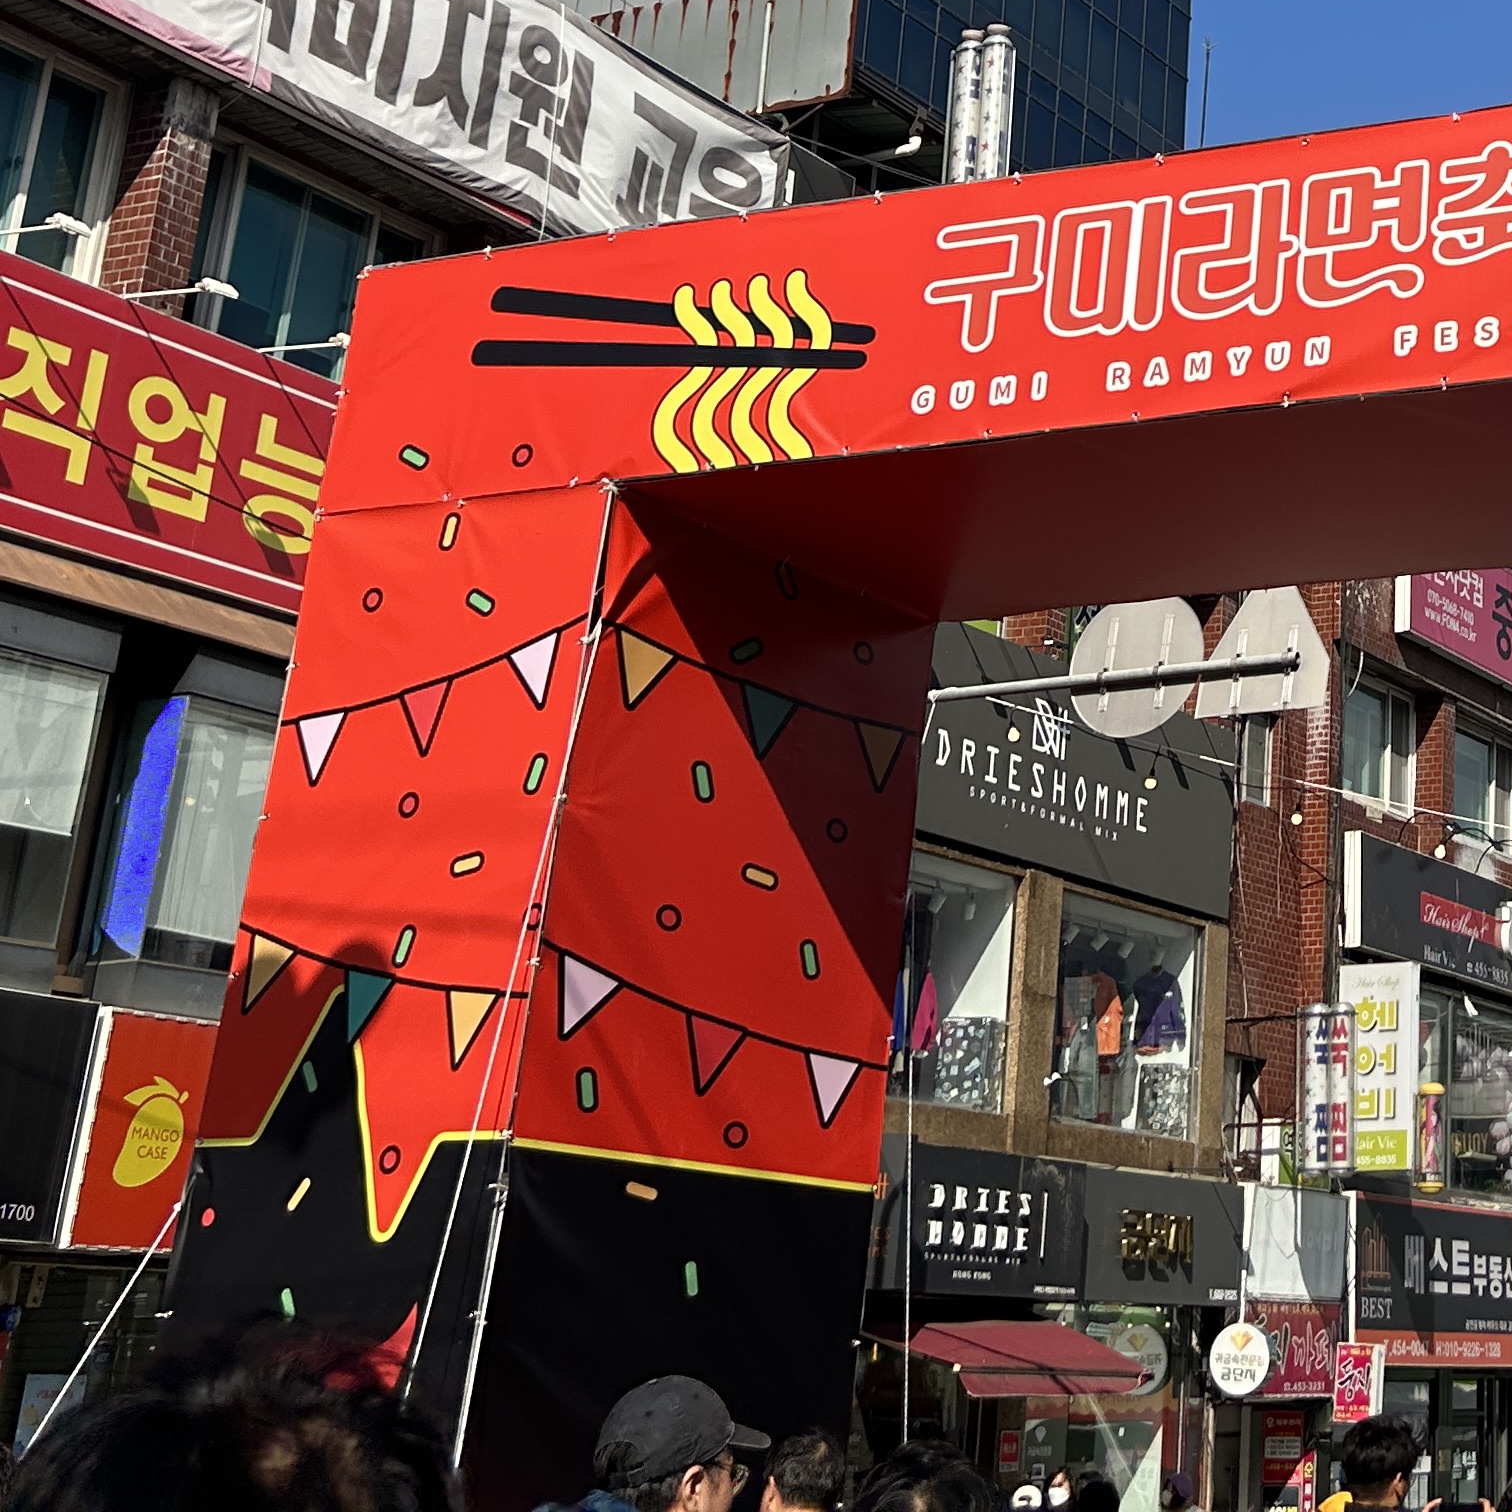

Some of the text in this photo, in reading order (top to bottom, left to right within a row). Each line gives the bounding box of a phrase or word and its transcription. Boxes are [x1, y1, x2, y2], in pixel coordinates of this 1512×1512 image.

[911, 369, 1049, 416] GUMI
[1105, 335, 1332, 393] RAMYUN
[0, 326, 326, 555] 직업능
[935, 728, 1149, 833] DRIESHOMME
[1095, 826, 1118, 841] MIX
[1423, 903, 1483, 953] Hair Shop
[1424, 944, 1443, 963] Hair
[1355, 995, 1398, 1121] 헤어비
[132, 1125, 180, 1143] MANGO
[1377, 1135, 1397, 1149] Vie
[137, 1143, 168, 1161] CASE
[928, 1183, 1032, 1218] DRIES
[0, 1204, 35, 1221] 1700
[1361, 1297, 1393, 1319] BEST
